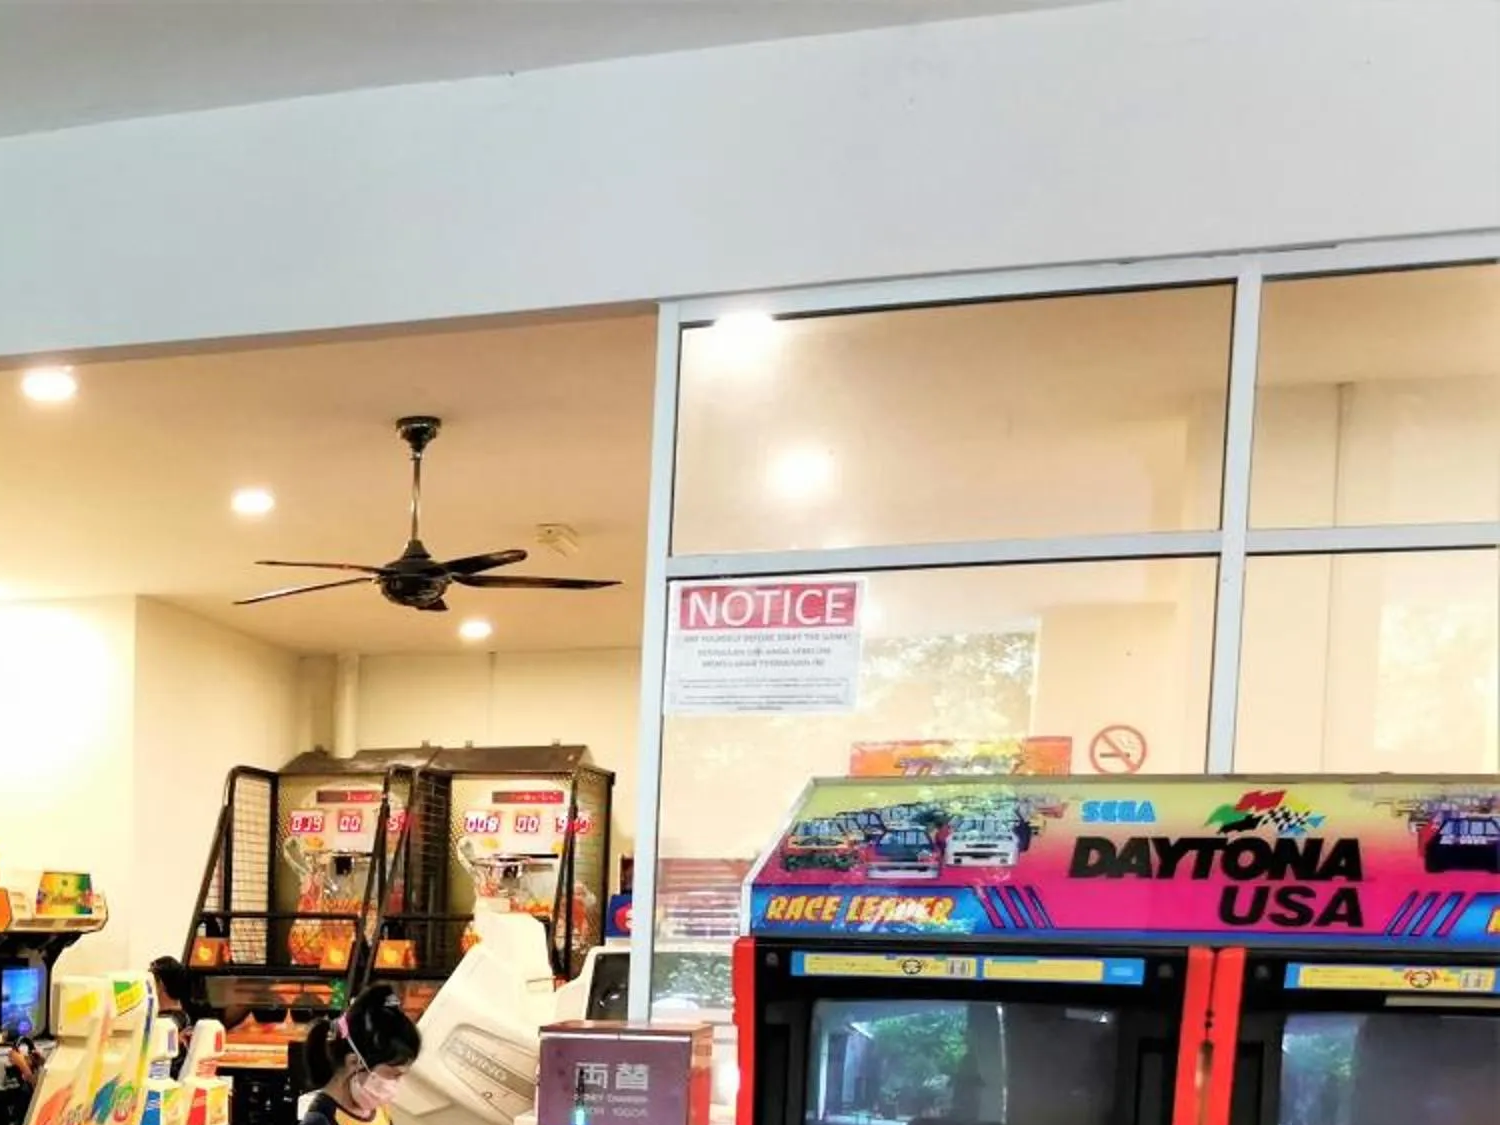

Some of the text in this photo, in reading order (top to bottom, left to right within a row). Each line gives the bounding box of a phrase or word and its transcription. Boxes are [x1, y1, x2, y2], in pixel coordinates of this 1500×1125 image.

[687, 587, 851, 627] NOTICE
[1080, 799, 1157, 824] SEGA
[1068, 835, 1364, 882] DAYTONA
[765, 894, 842, 922] RACE
[1218, 885, 1364, 928] USA
